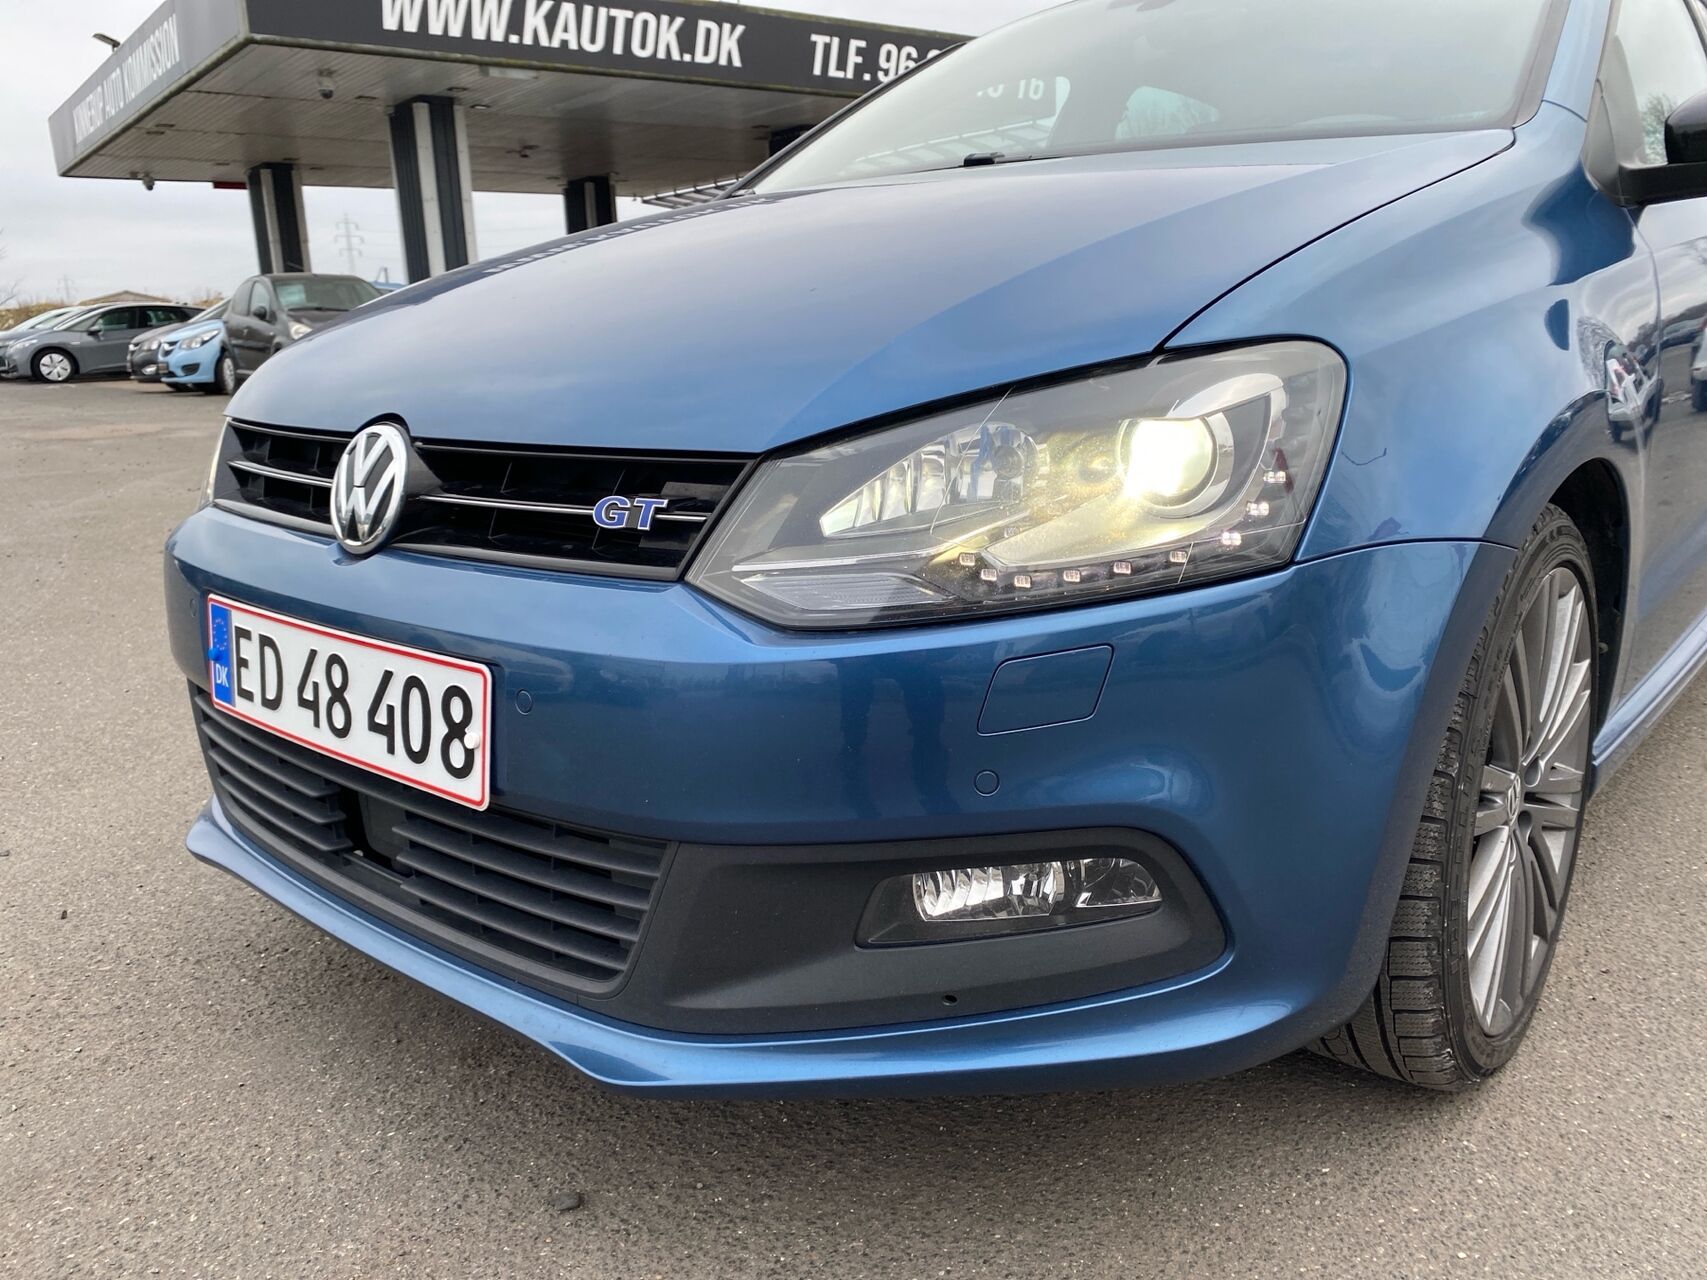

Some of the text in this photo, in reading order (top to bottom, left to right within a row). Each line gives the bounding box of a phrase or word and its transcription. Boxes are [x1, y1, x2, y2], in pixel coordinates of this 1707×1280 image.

[382, 0, 746, 67] WWW.KAUTOK.DK
[810, 33, 871, 81] TLF.
[877, 43, 918, 83] 96
[103, 67, 124, 119] AUTO
[121, 13, 179, 104] KOMMISSION
[592, 495, 668, 531] GT
[215, 663, 229, 687] DK
[233, 625, 475, 780] ED 48 408
